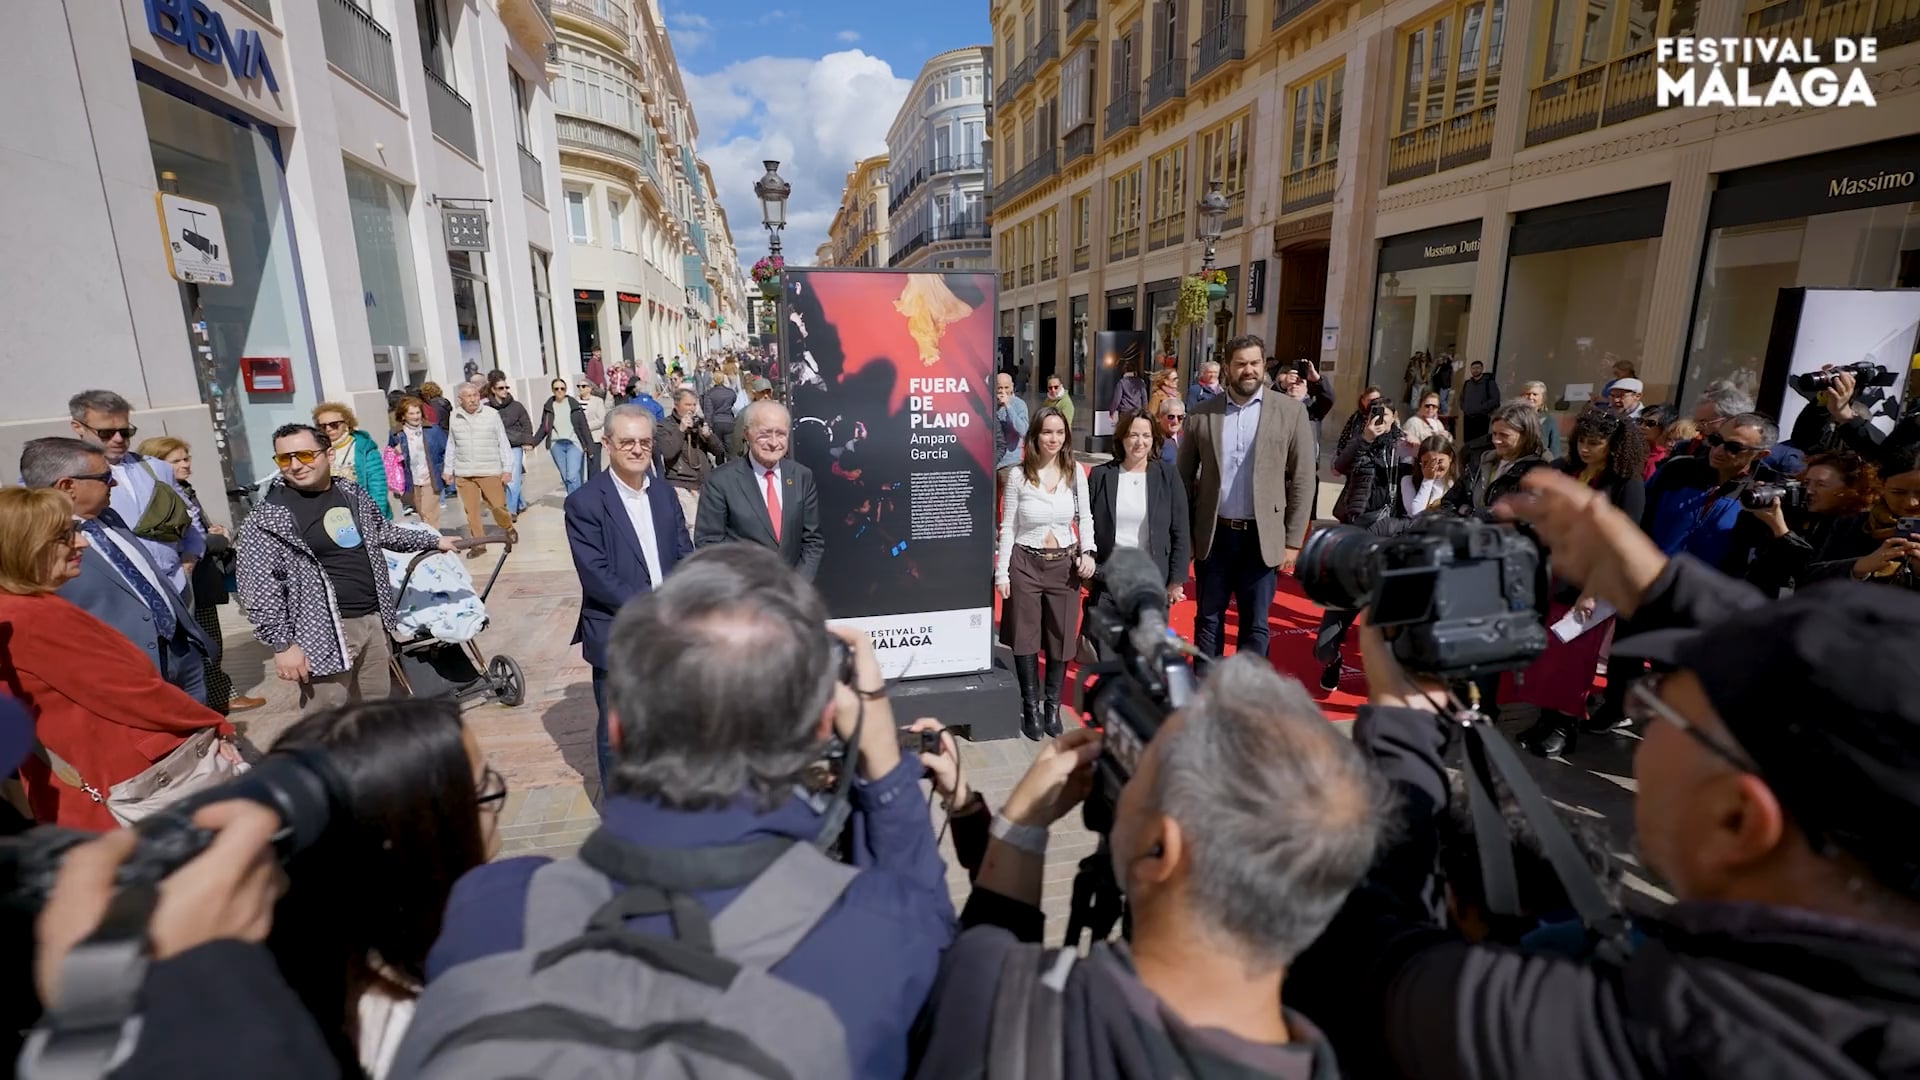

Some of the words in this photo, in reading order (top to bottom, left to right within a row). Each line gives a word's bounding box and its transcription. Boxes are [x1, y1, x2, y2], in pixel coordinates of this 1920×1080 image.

[144, 0, 280, 92] BBVA
[1828, 171, 1915, 198] Massimo
[1424, 243, 1457, 258] Massimo
[1460, 238, 1481, 253] Dutti
[910, 377, 970, 394] FUERA
[910, 396, 934, 412] DE
[910, 412, 970, 429] PLANO
[910, 433, 957, 446] Amparo
[910, 447, 949, 460] García
[919, 625, 934, 634] DE
